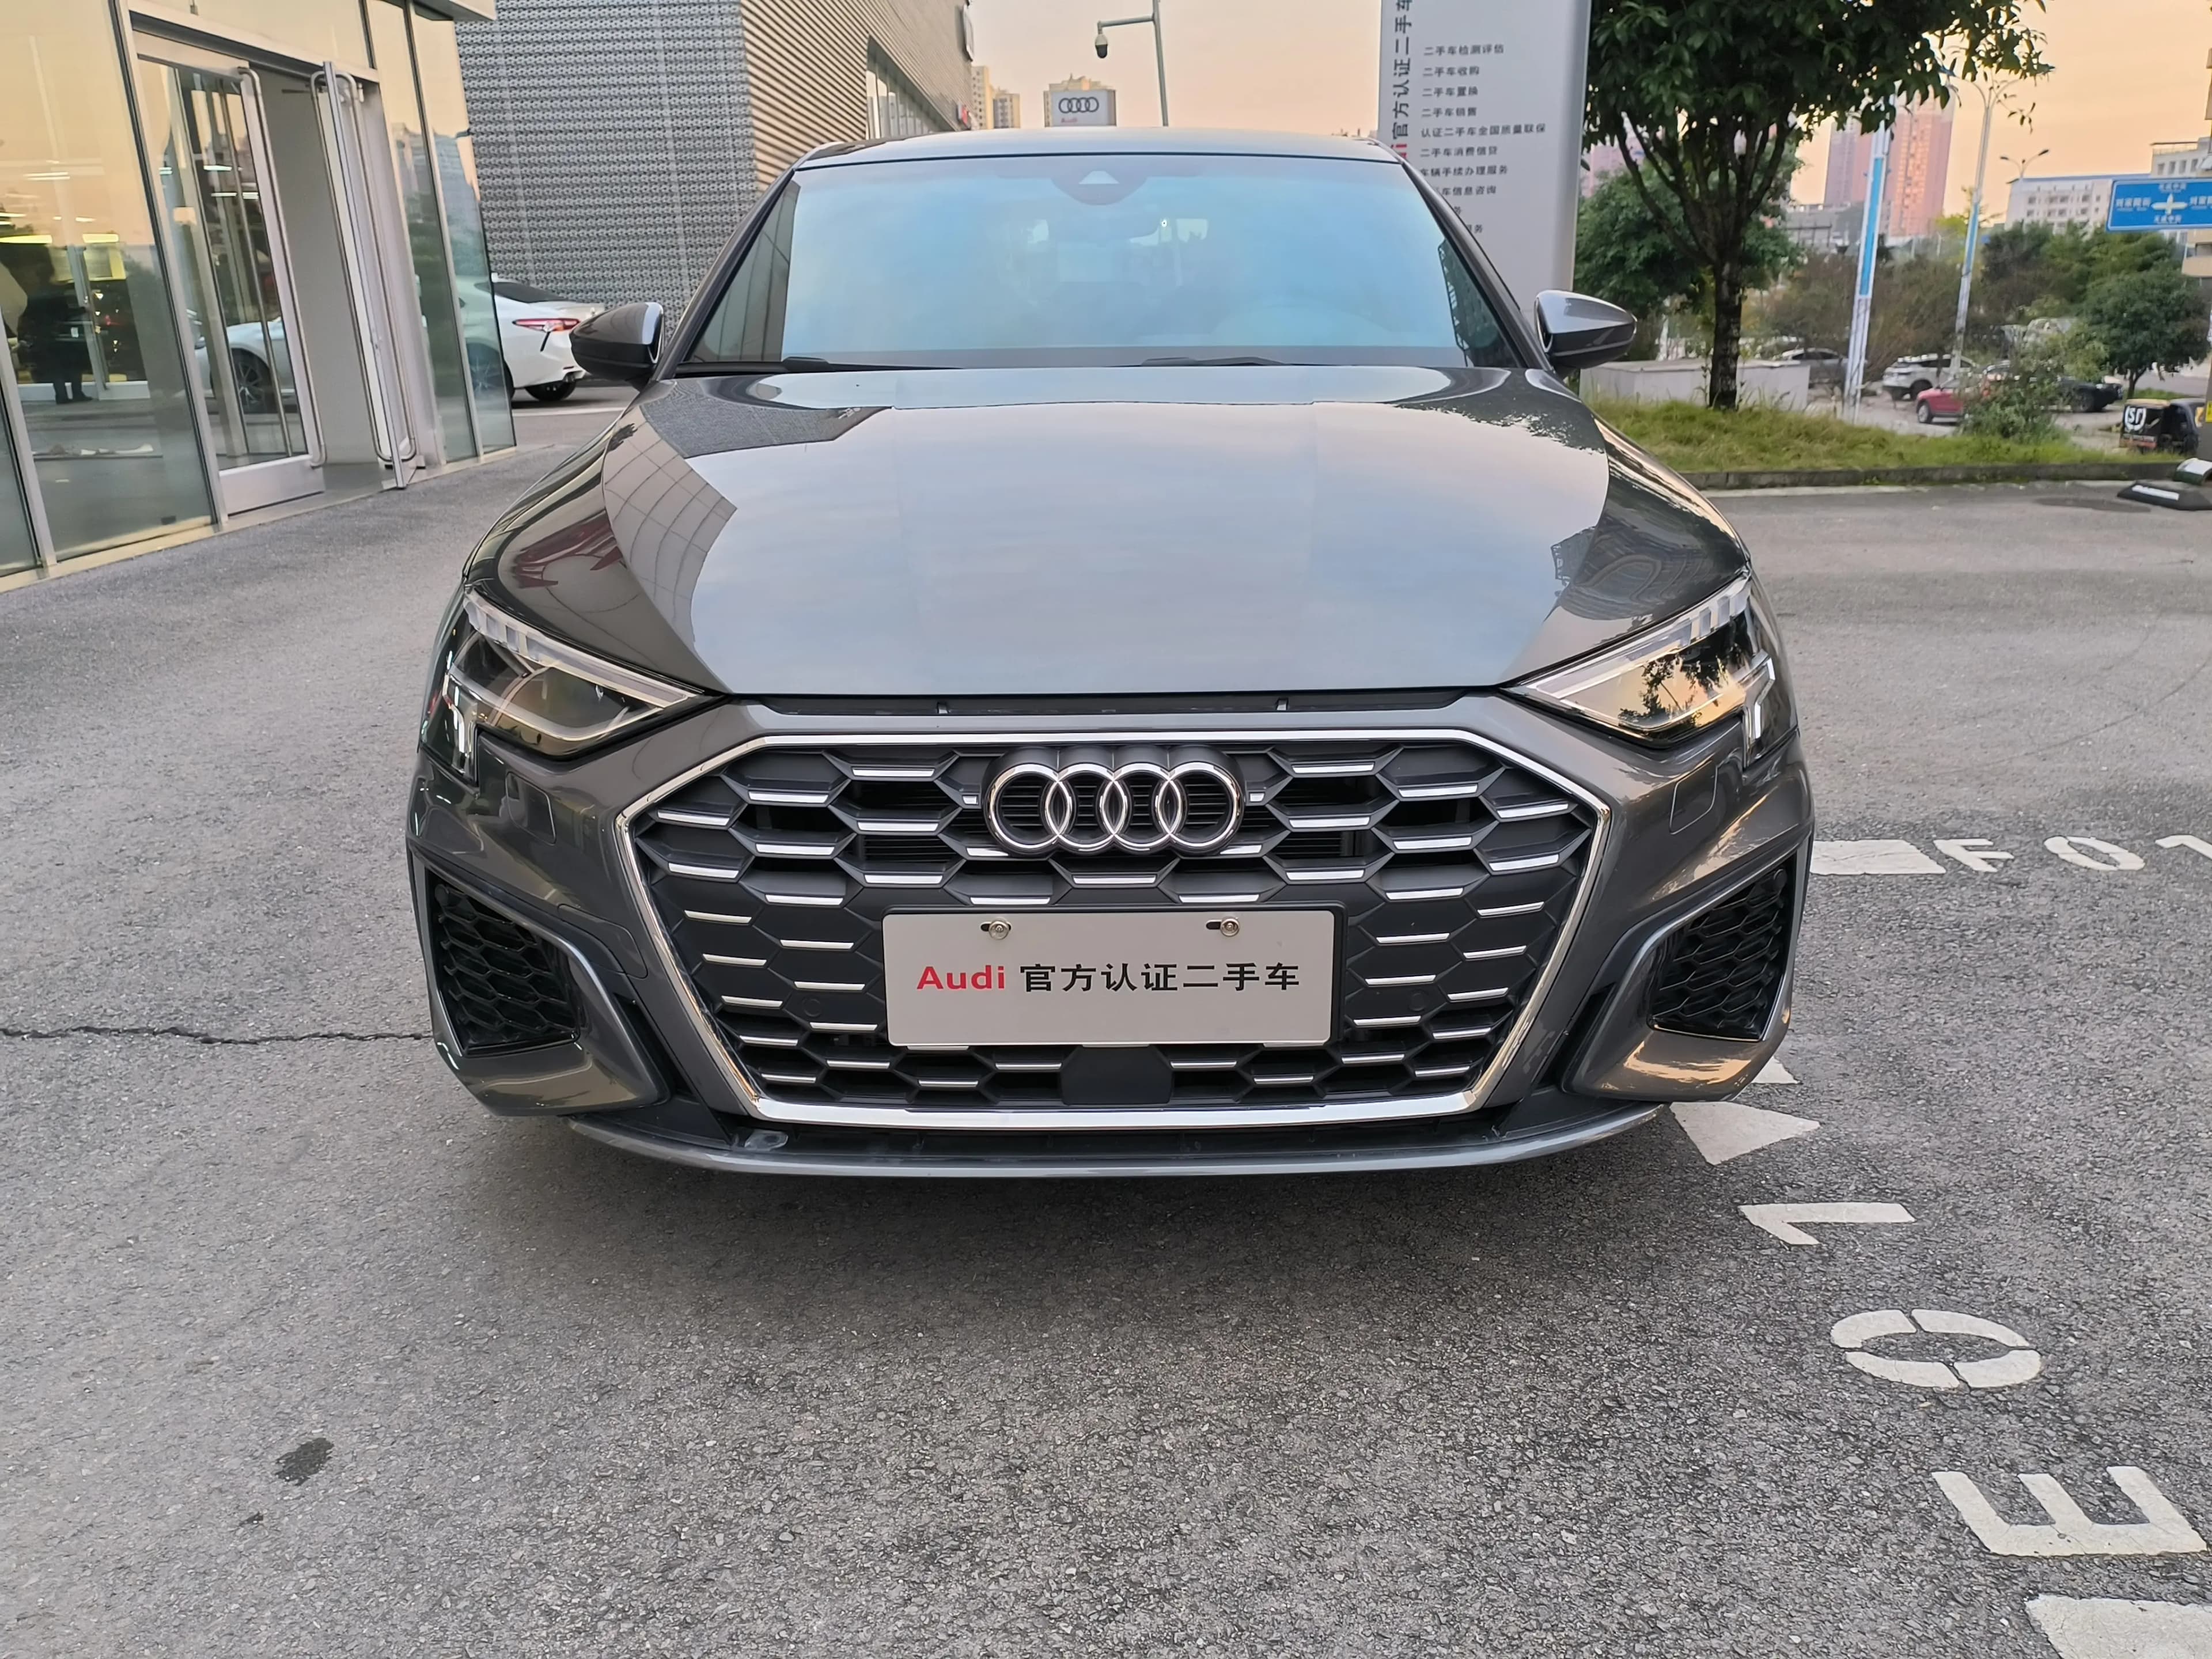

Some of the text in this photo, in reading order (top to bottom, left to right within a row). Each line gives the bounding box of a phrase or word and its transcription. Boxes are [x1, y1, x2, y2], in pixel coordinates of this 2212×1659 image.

[1423, 44, 1504, 56] 二手车检测评估
[1392, 0, 1412, 139] 官方认证二手车
[1422, 66, 1480, 77] 二手车收购
[1422, 86, 1478, 97] 二手车置换
[1421, 107, 1477, 118] 二手车销售
[1421, 123, 1546, 138] 认证二手车全国质量联保
[1420, 146, 1498, 157] 二手车消费信贷
[1420, 165, 1508, 177] 车辆手续办理服务
[916, 962, 1300, 993] Audi 官方认证二手车
